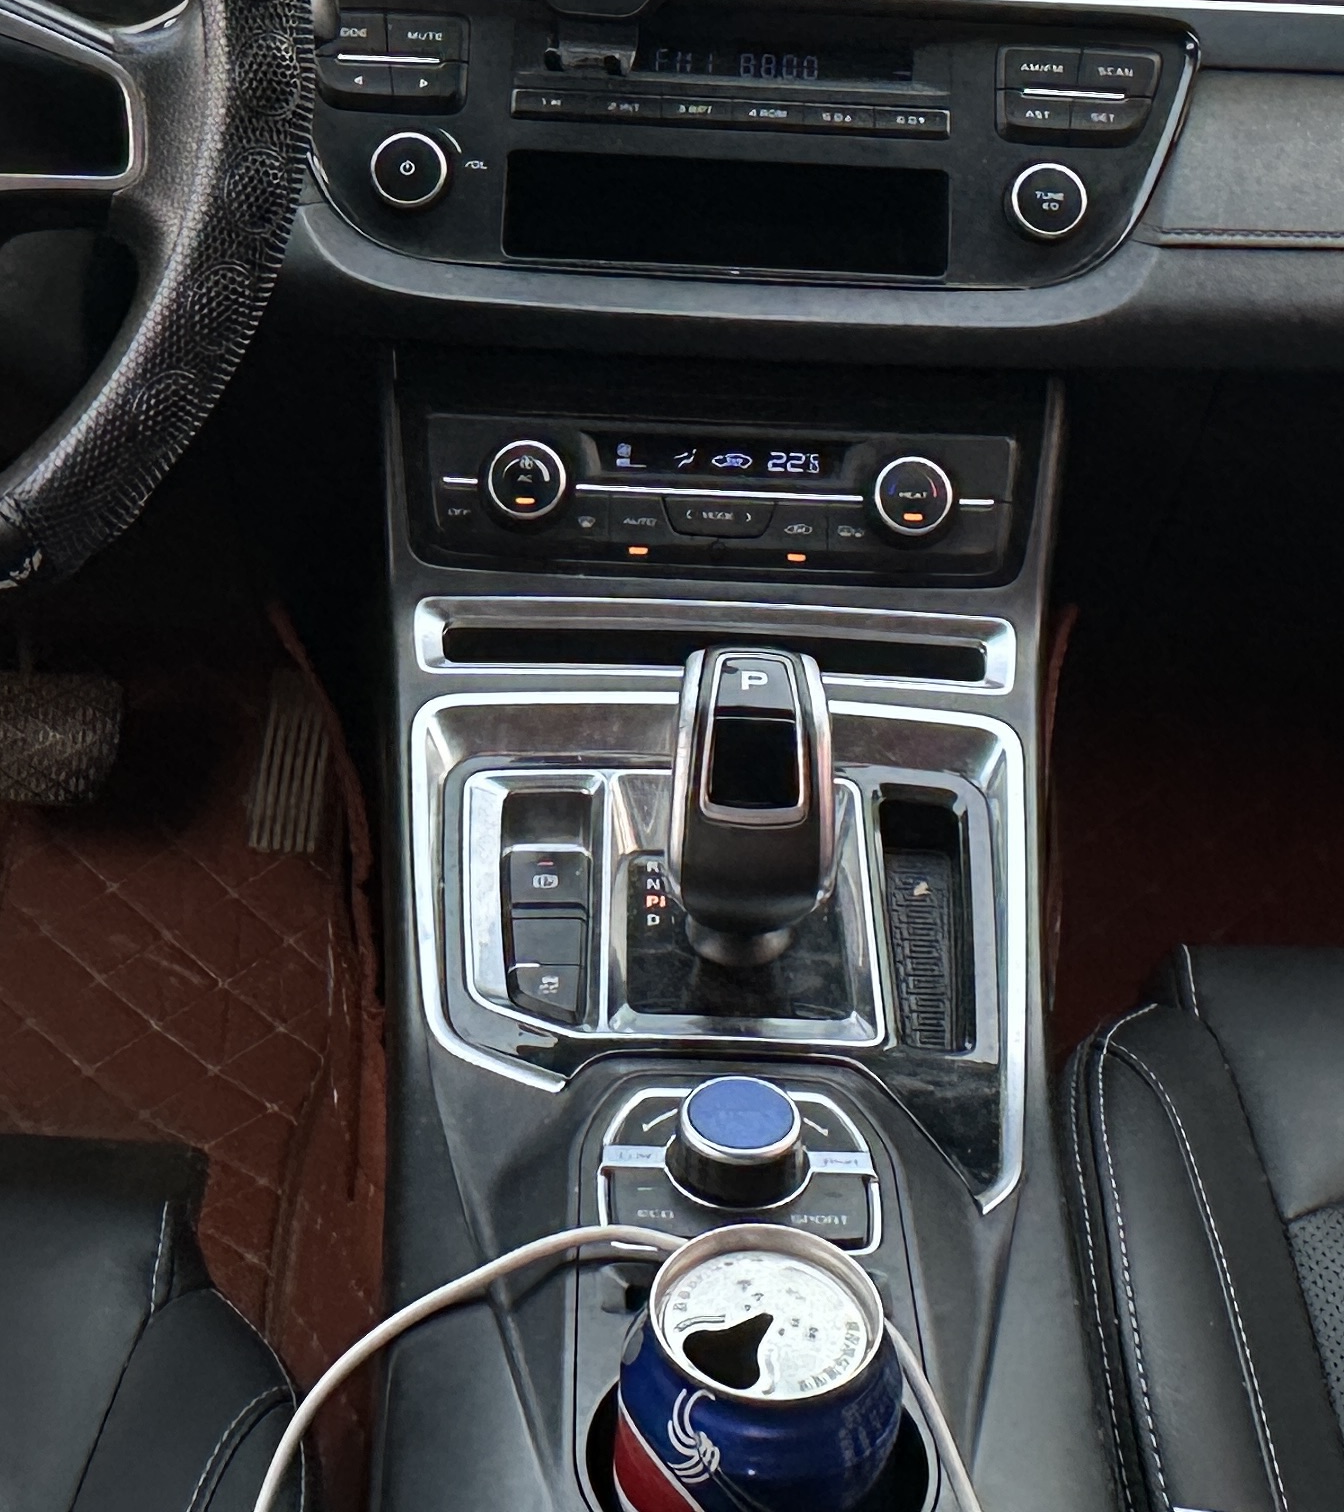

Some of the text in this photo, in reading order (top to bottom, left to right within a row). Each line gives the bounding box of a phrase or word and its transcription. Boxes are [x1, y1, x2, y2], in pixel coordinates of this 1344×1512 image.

[407, 31, 442, 41] MUTE
[1097, 67, 1134, 78] SCAN
[622, 516, 657, 527] AUTO
[741, 670, 768, 690] P
[646, 878, 661, 890] N
[646, 913, 660, 926] D
